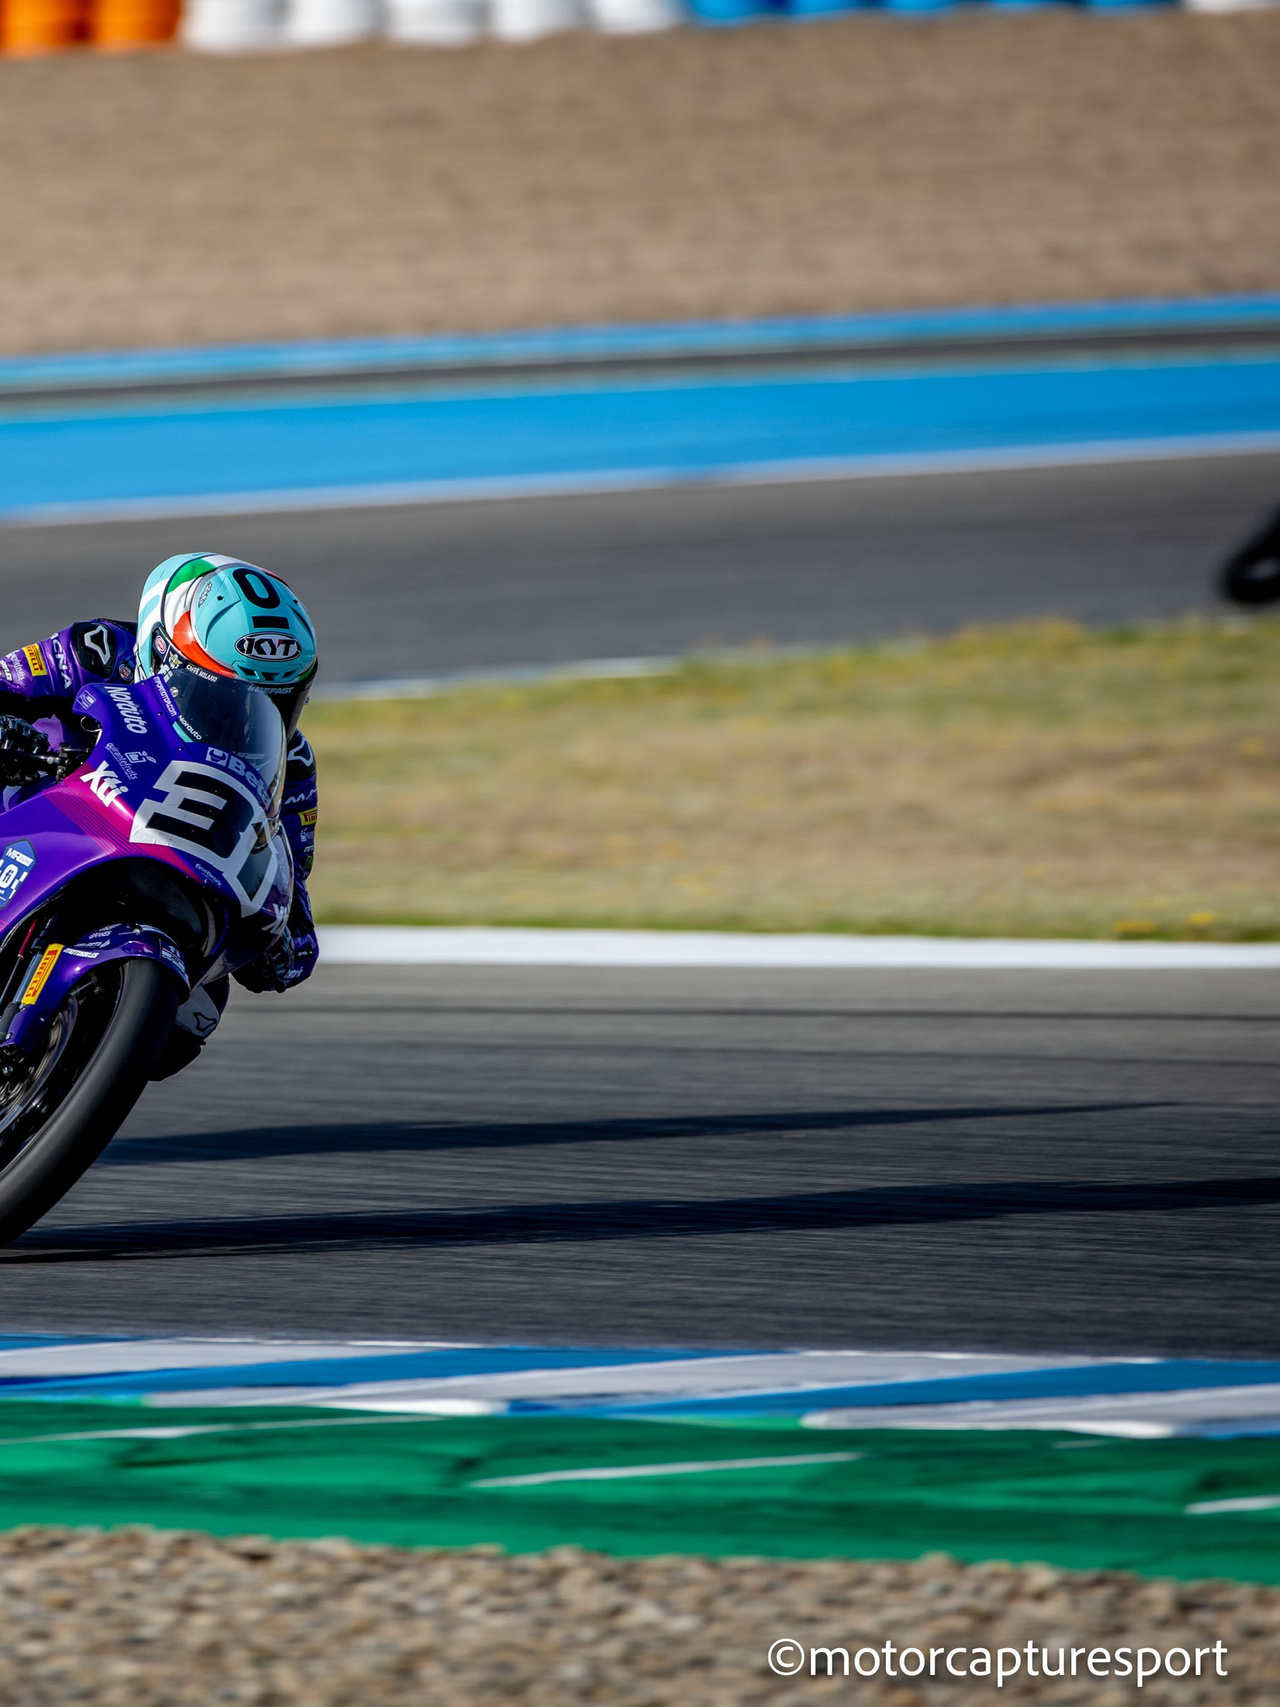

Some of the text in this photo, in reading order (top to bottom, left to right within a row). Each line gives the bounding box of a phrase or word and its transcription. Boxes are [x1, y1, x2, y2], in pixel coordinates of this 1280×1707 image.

[245, 637, 297, 656] KYT
[104, 686, 148, 734] Norauto
[178, 715, 202, 740] Norauto
[80, 760, 128, 807] Xti
[25, 949, 59, 998] PIRELLI
